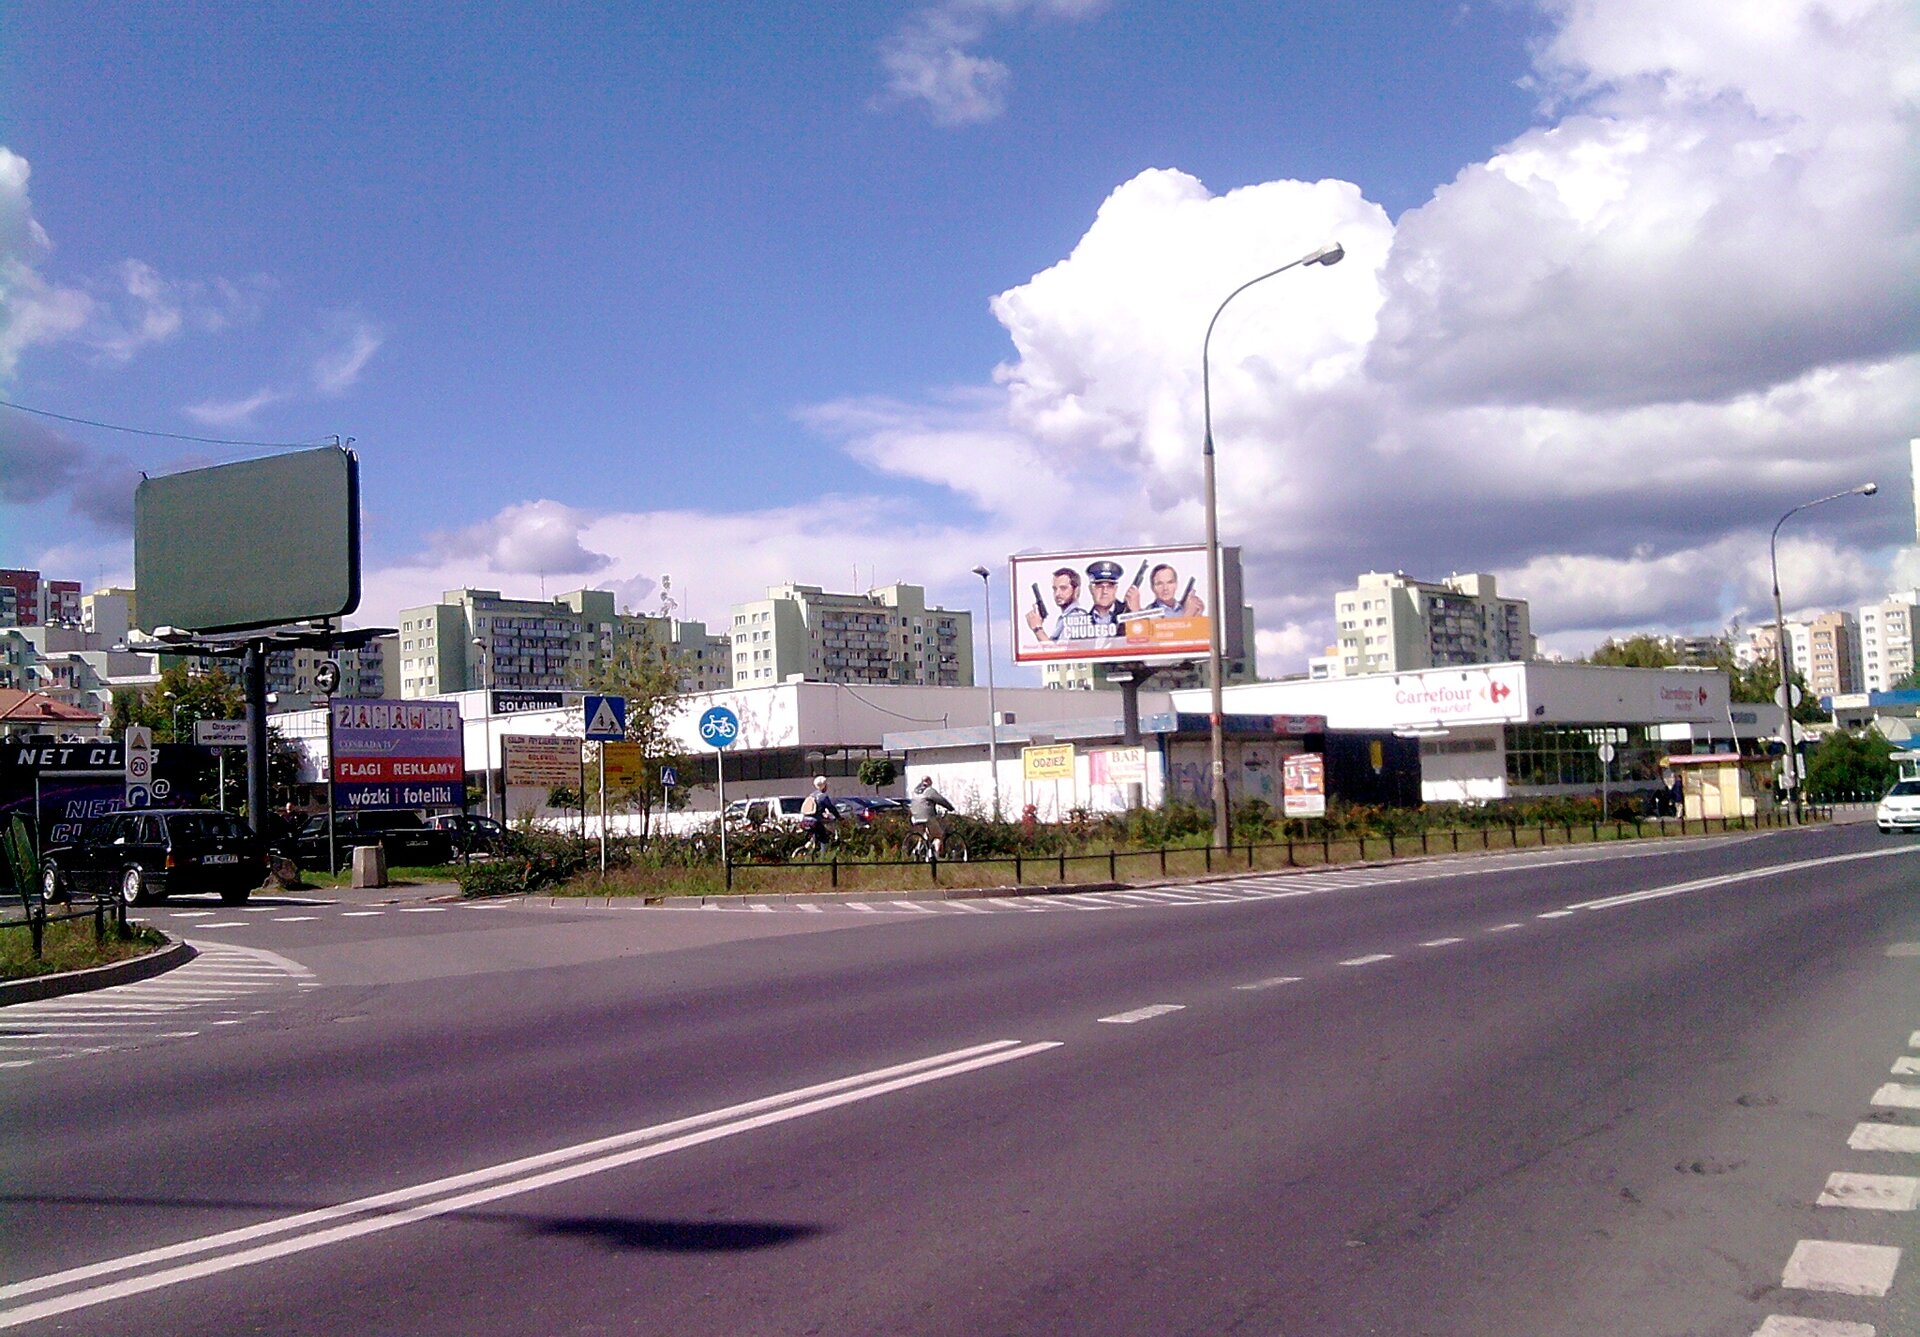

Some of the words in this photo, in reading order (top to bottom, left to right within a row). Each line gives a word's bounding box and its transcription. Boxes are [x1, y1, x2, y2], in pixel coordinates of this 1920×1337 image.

[1063, 623, 1117, 639] CHUDEGO
[1395, 687, 1472, 705] Carrefour
[498, 700, 558, 712] SOLARIUM
[1430, 703, 1472, 714] market
[338, 705, 455, 730] ZAAWI
[17, 749, 74, 765] NET
[89, 749, 160, 765] CLB
[1112, 750, 1140, 763] BAR
[134, 761, 145, 772] 20
[341, 763, 382, 775] FLAGI
[393, 762, 456, 775] REKLAMY
[348, 787, 390, 805] wózki
[403, 787, 451, 804] foteliki
[65, 799, 125, 819] NET
